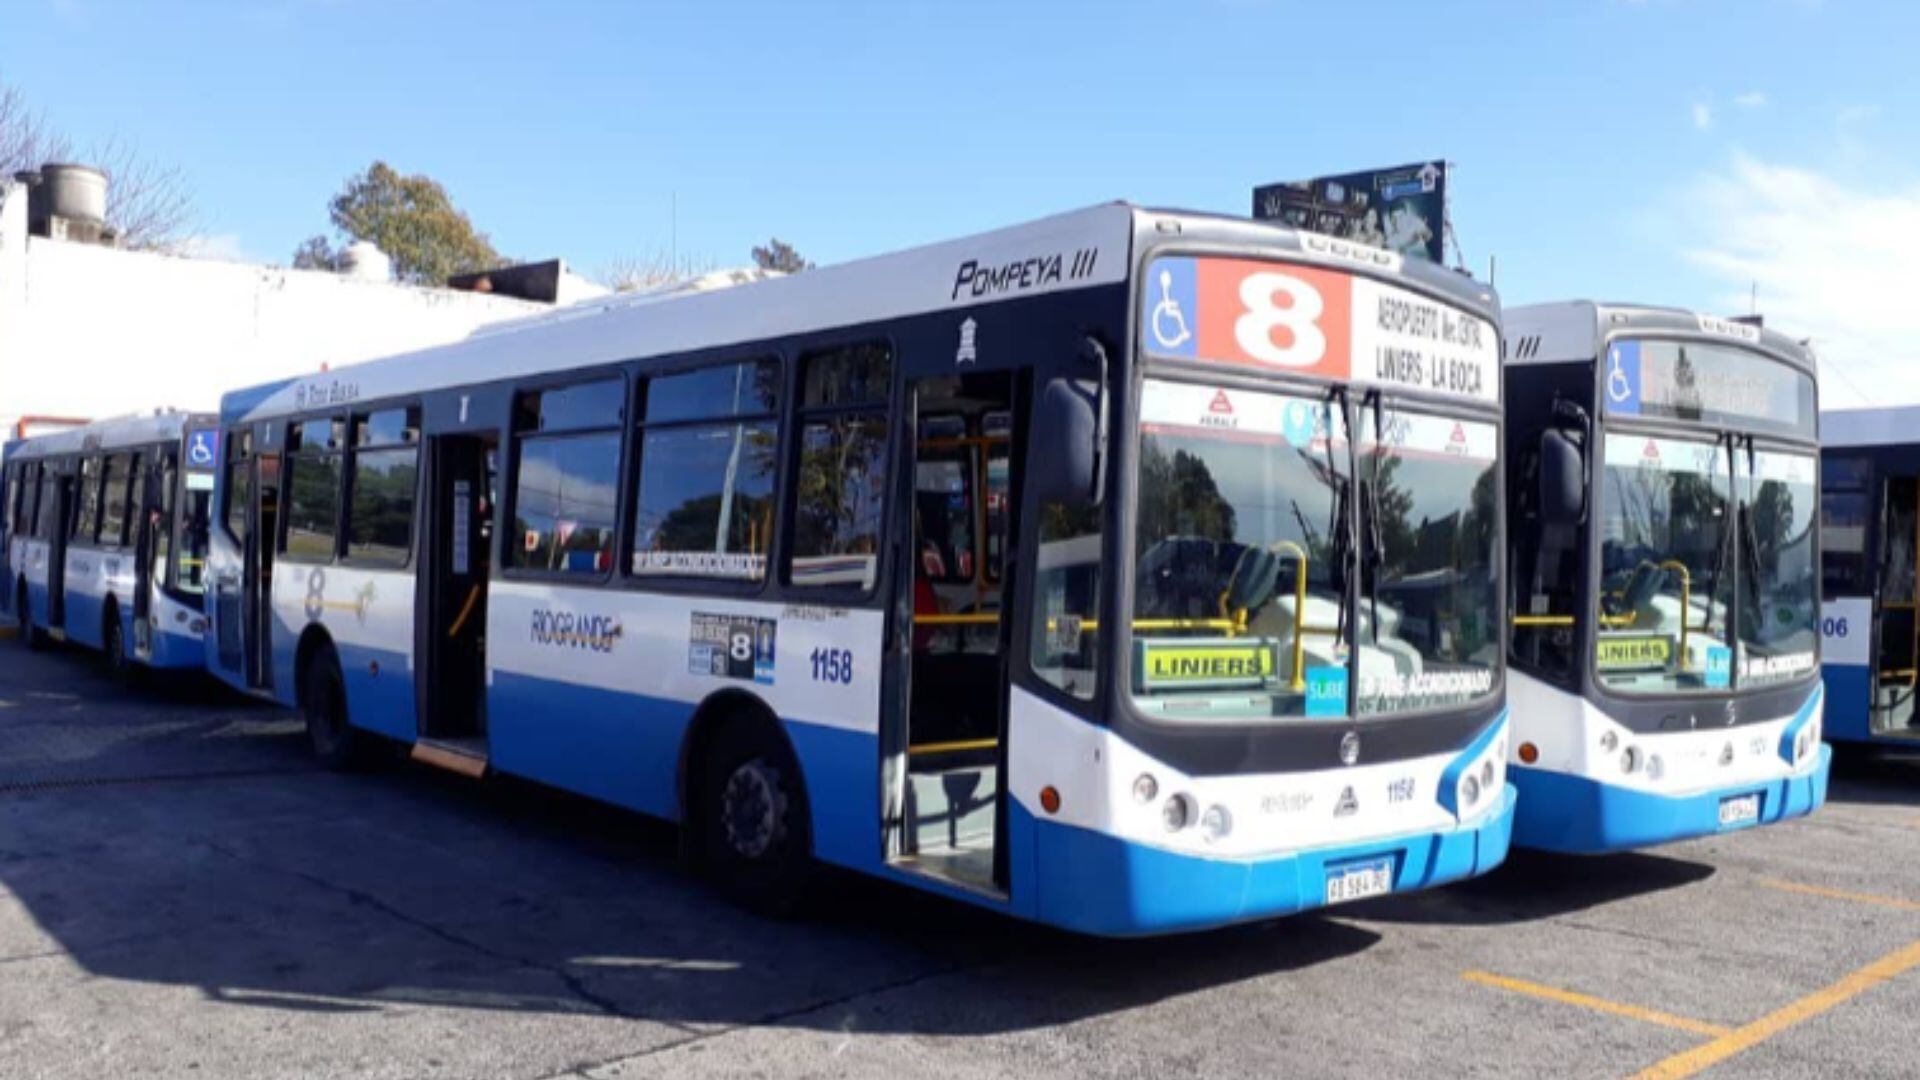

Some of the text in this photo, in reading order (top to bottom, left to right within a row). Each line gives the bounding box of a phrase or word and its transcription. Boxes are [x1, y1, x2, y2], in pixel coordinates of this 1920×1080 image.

[952, 253, 1063, 301] POMPEYA
[1234, 271, 1327, 368] 8
[1377, 295, 1438, 341] AEROPUERTO
[1376, 344, 1423, 385] LINIERS
[1432, 354, 1447, 389] LA
[1449, 357, 1482, 394] BOCA
[529, 609, 613, 653] RIOGRANDE
[730, 632, 751, 662] 8
[810, 647, 853, 684] 1158
[1154, 657, 1263, 677] LINIERS
[1310, 680, 1344, 700] SUBE
